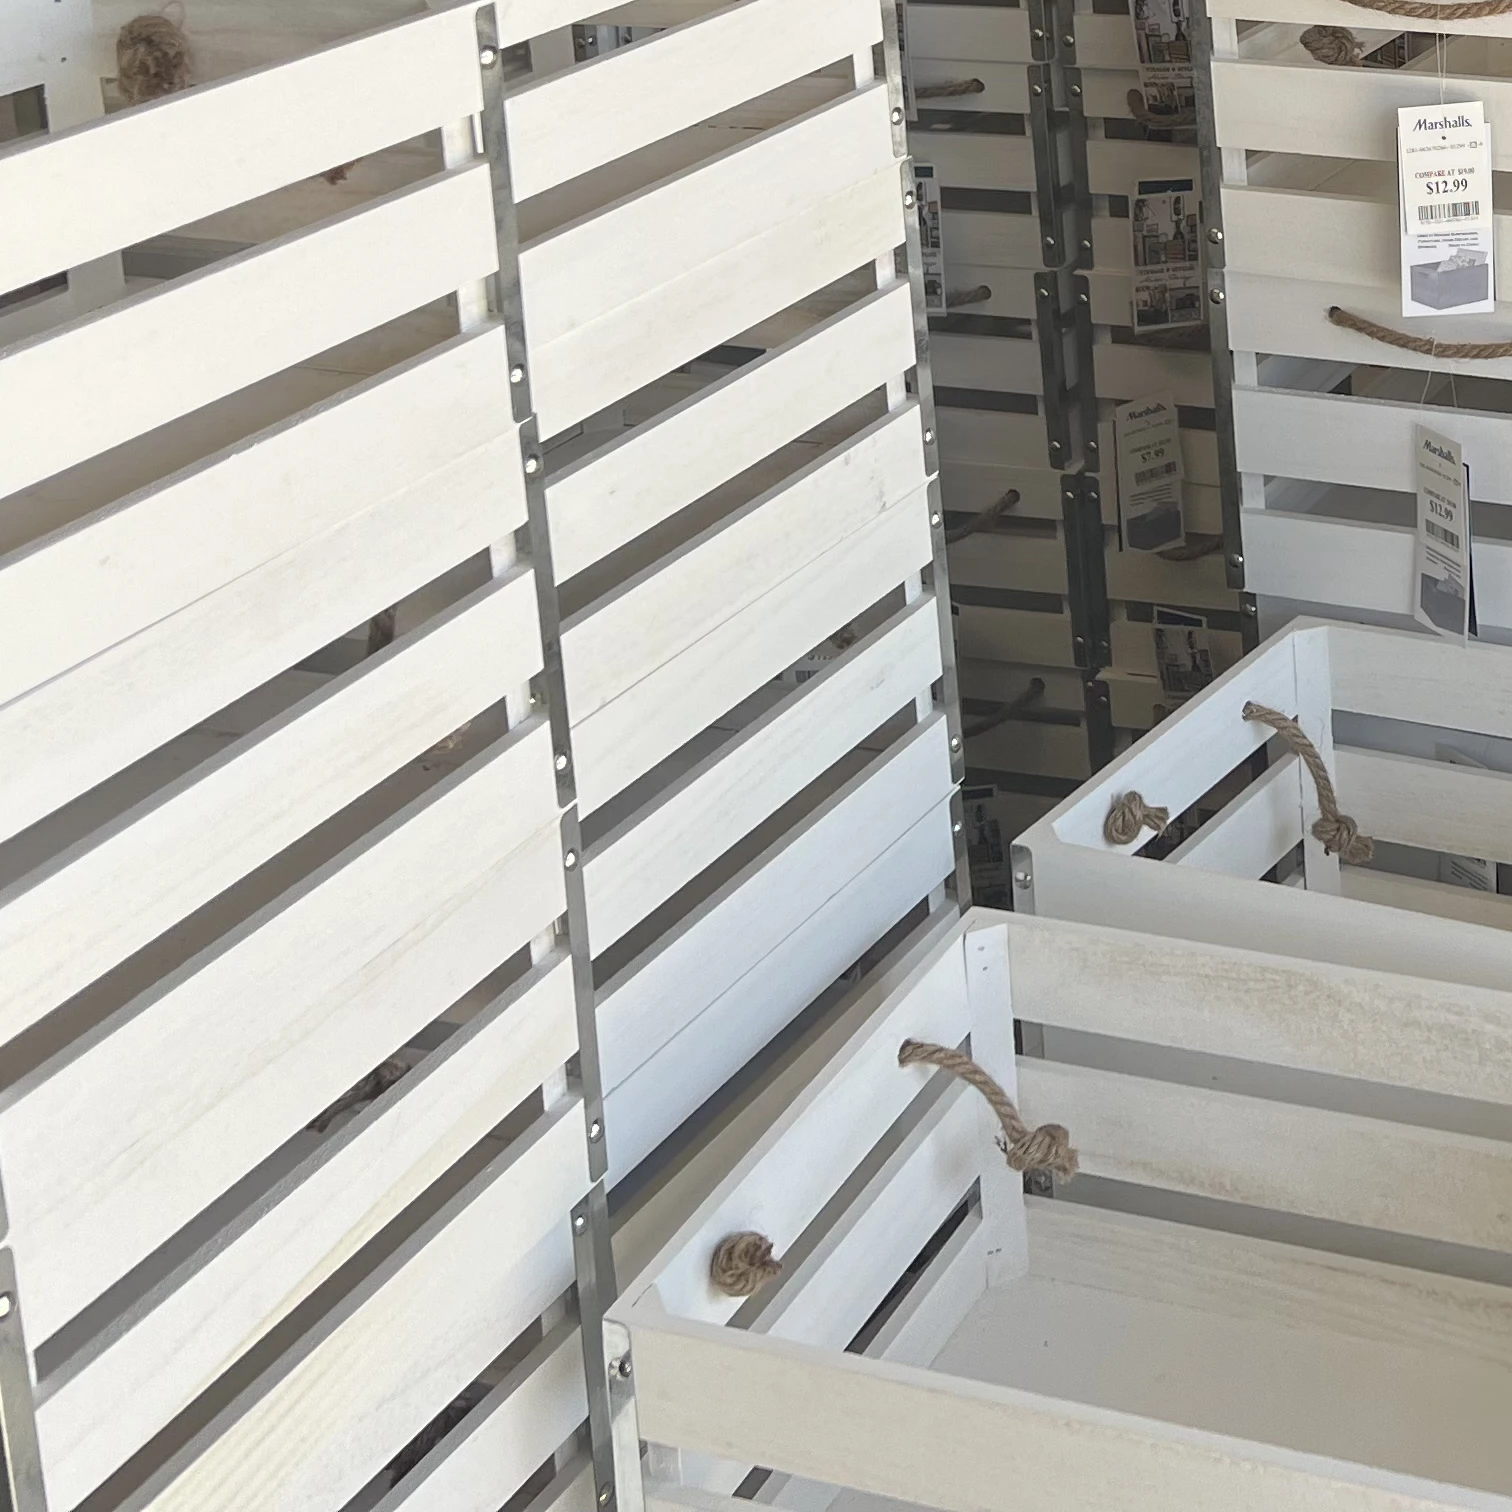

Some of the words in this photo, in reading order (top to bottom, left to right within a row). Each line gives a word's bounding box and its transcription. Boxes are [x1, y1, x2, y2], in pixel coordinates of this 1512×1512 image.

[1412, 115, 1472, 132] Marshalls
[1414, 169, 1445, 179] COMPARE
[1426, 178, 1468, 195] $12.99
